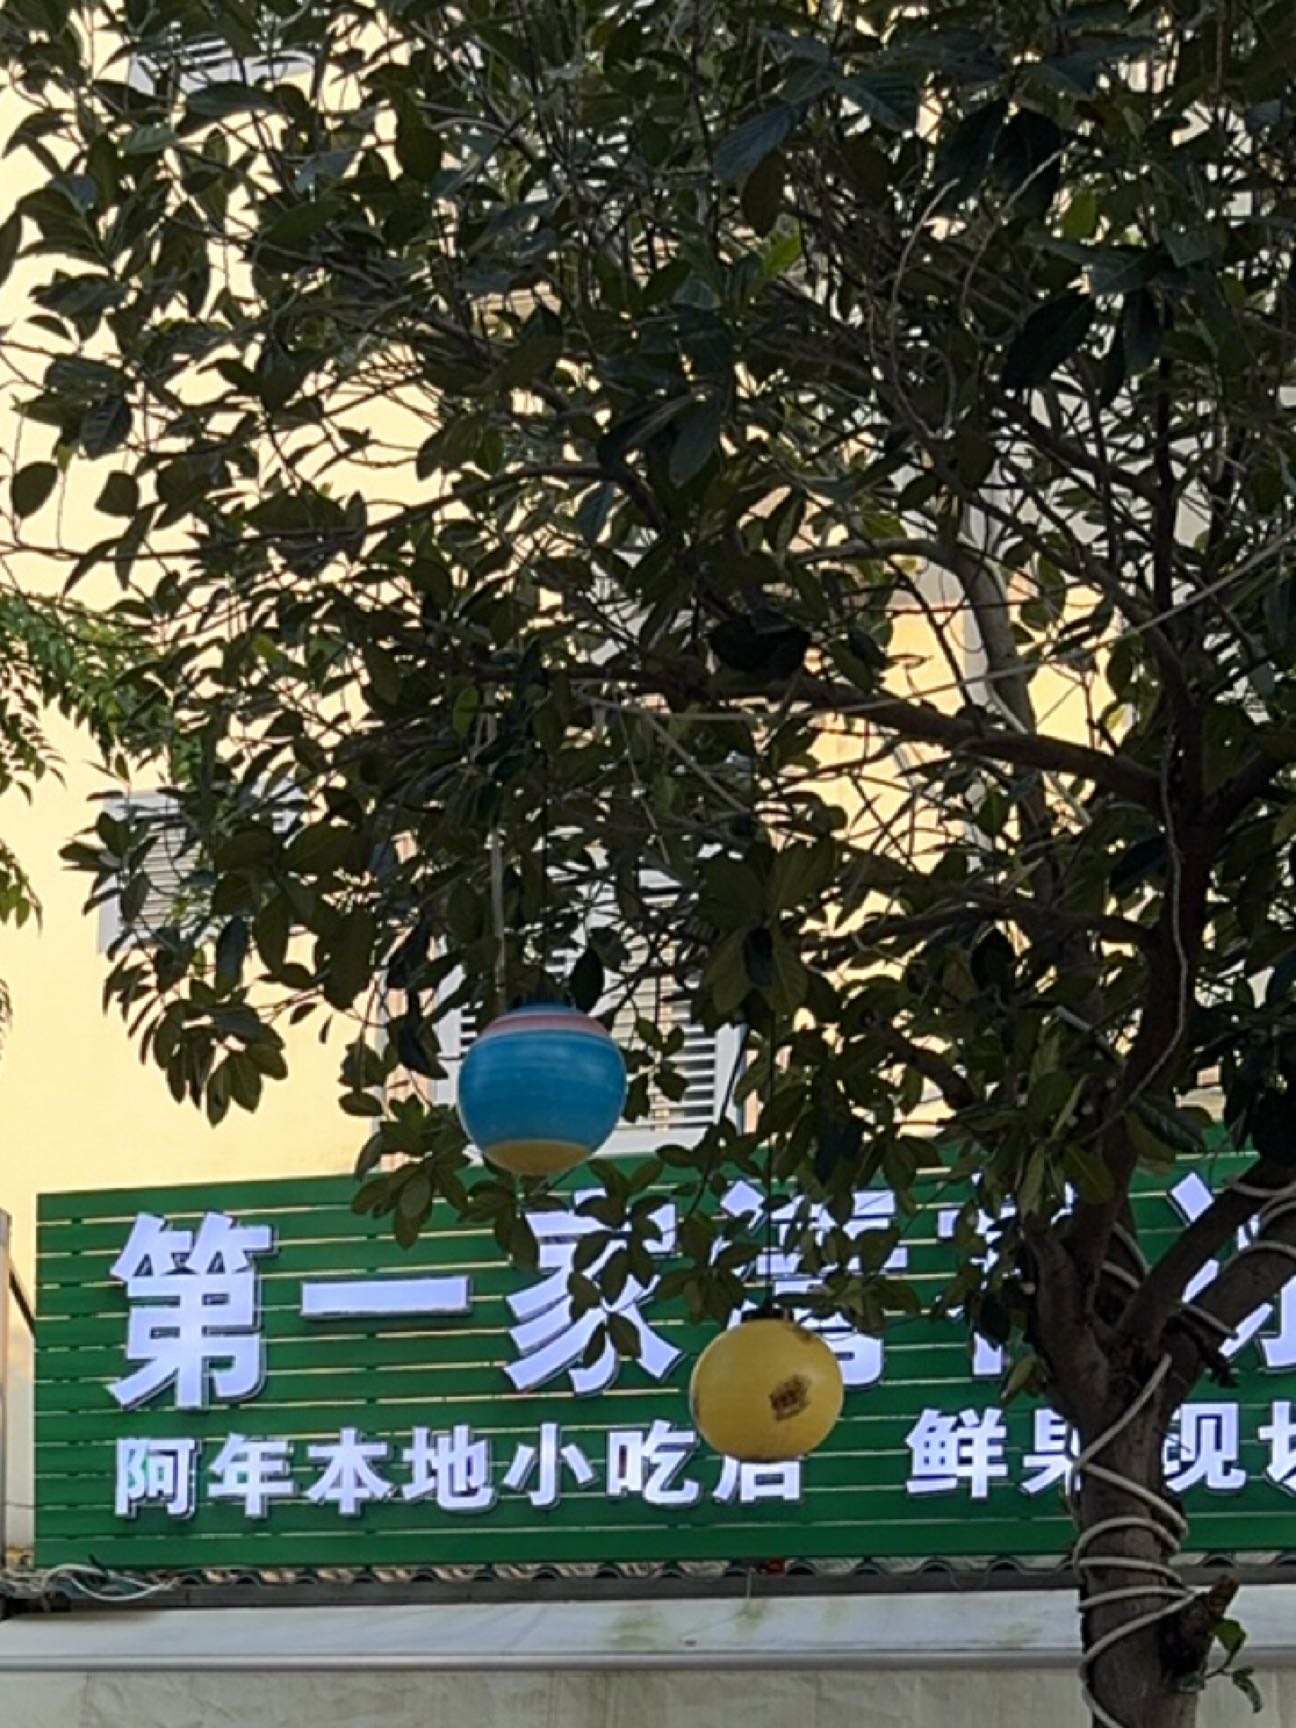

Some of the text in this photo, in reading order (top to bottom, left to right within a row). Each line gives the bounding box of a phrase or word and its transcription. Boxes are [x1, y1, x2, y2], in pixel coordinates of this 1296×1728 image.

[115, 1419, 801, 1518] 阿年本地小吃店
